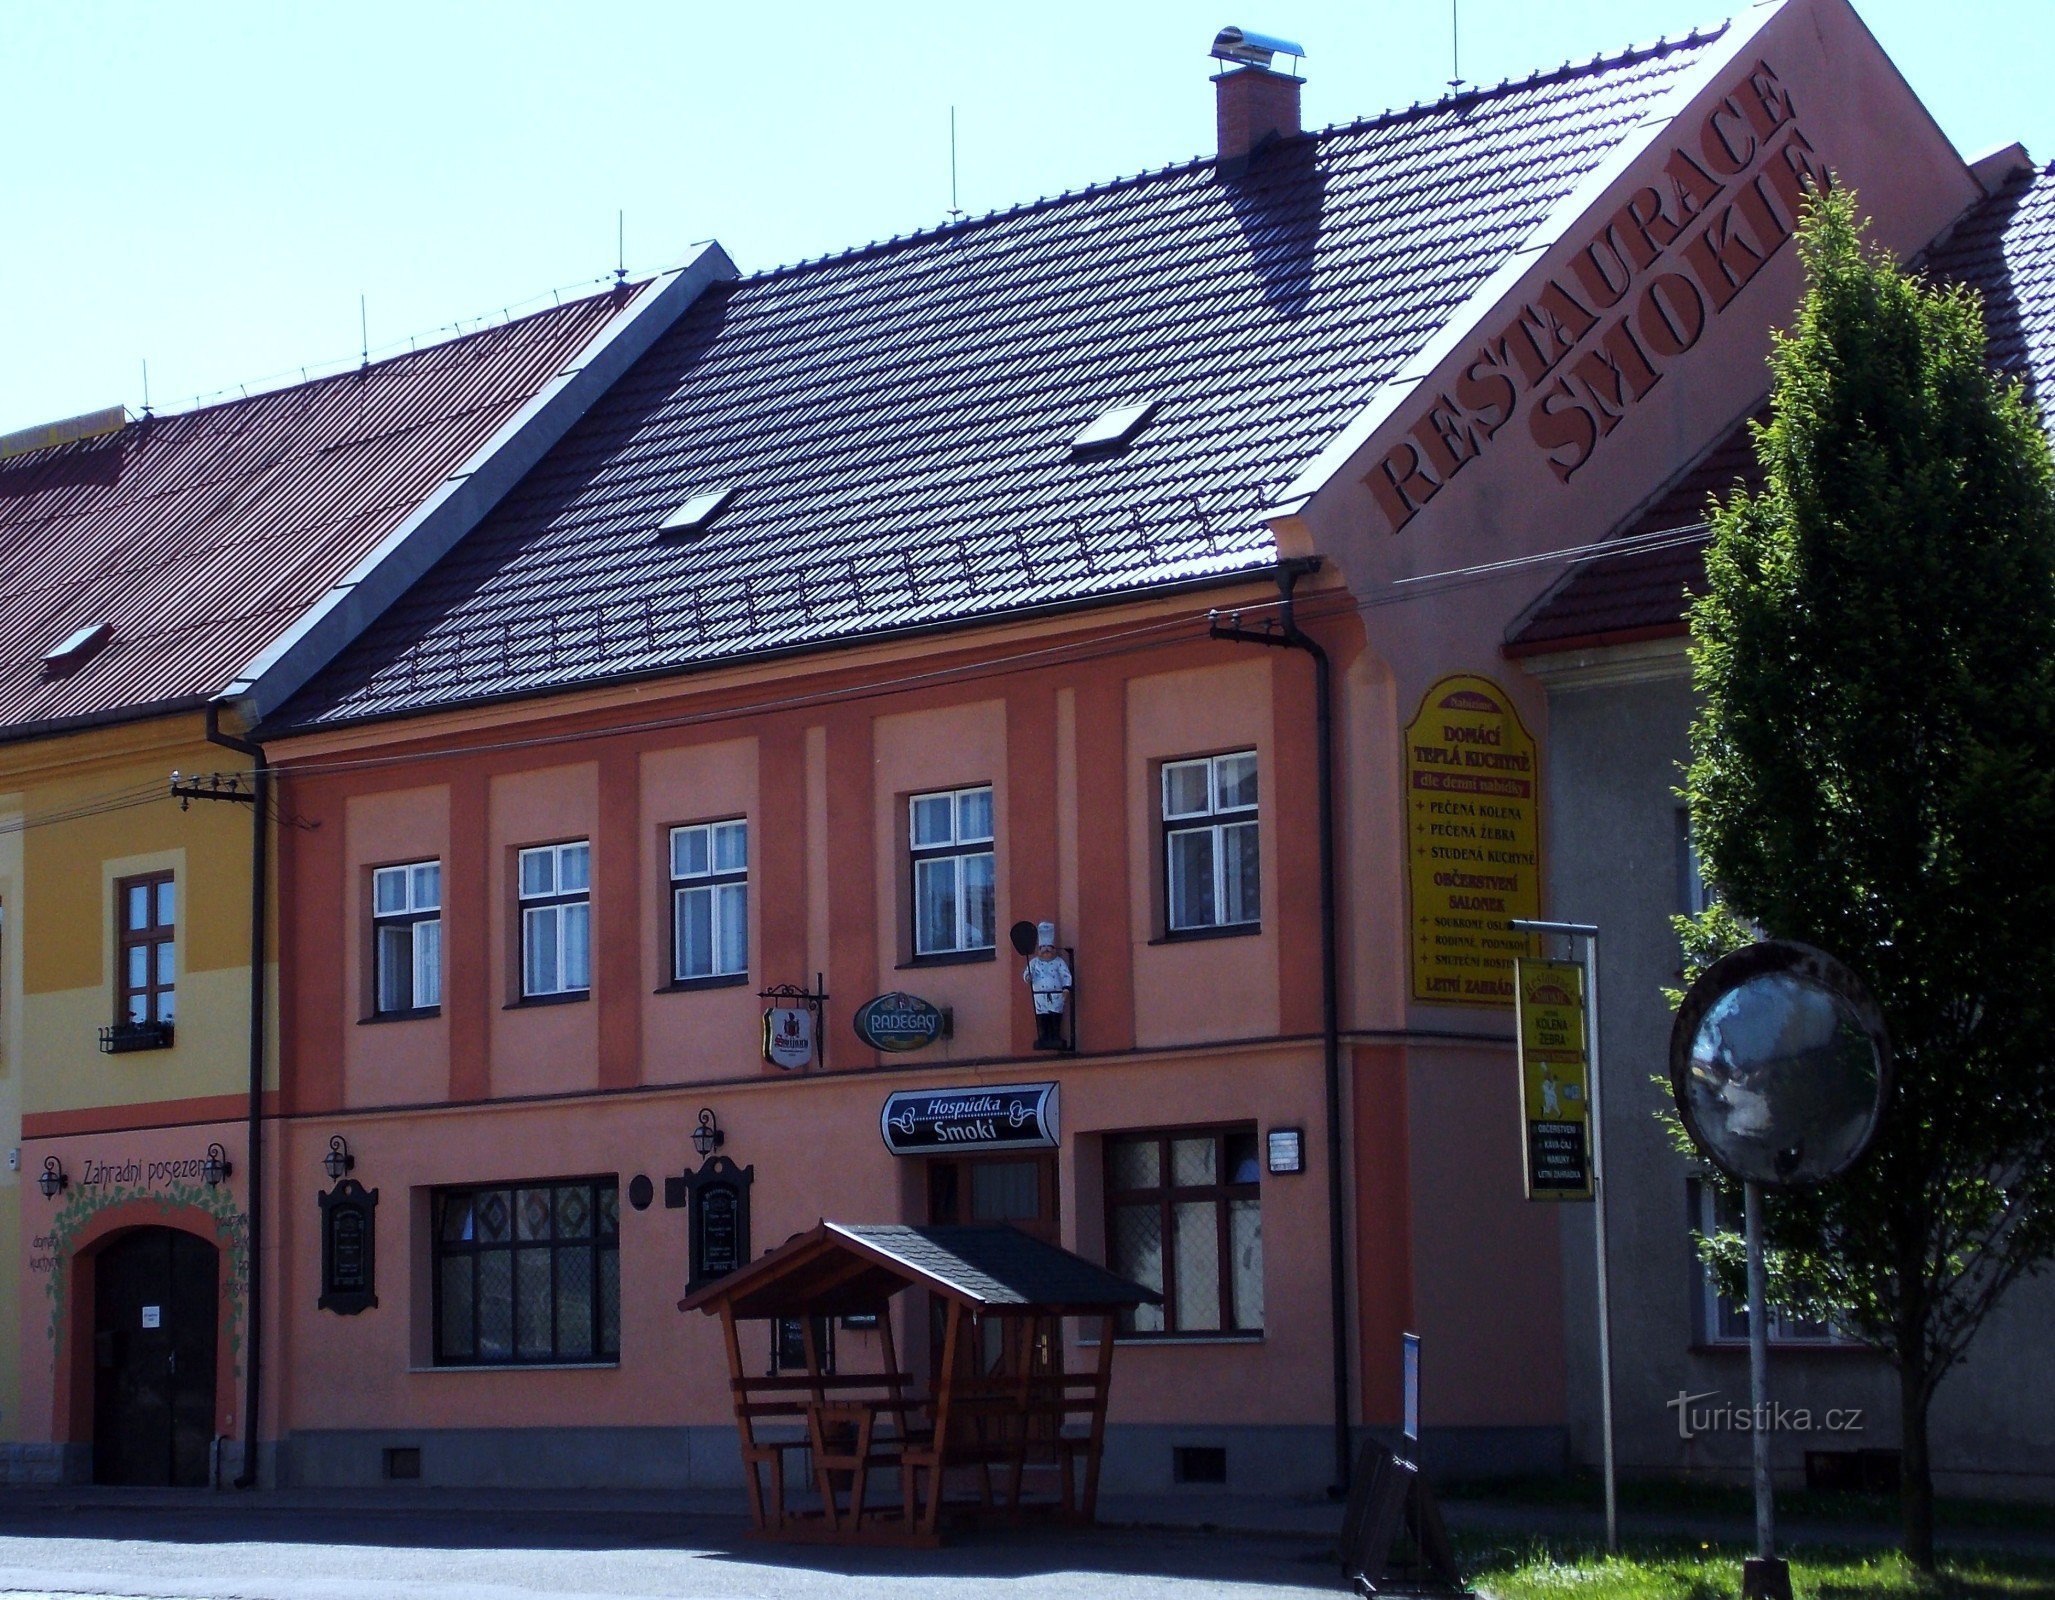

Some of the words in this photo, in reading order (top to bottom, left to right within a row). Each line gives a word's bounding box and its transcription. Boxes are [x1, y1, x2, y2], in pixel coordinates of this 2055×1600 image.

[1359, 59, 1796, 533] RESTAURACE
[1530, 127, 1832, 484] SMOKIE
[1414, 745, 1463, 766] TEPLÁ
[1430, 799, 1475, 817] PEČENÁ
[1479, 805, 1522, 820] KOLENA
[1430, 821, 1476, 838] PEČENÁ
[1481, 824, 1516, 841] ŽEBRA
[1431, 844, 1484, 862] STUDENÁ
[1433, 869, 1519, 892] OBČERSTVENÍ
[1448, 895, 1506, 913] SALONEK
[871, 1014, 938, 1036] RADEGAST
[926, 1096, 1001, 1120] Hospůdka
[934, 1120, 997, 1142] Smoki
[148, 1159, 206, 1191] posezen
